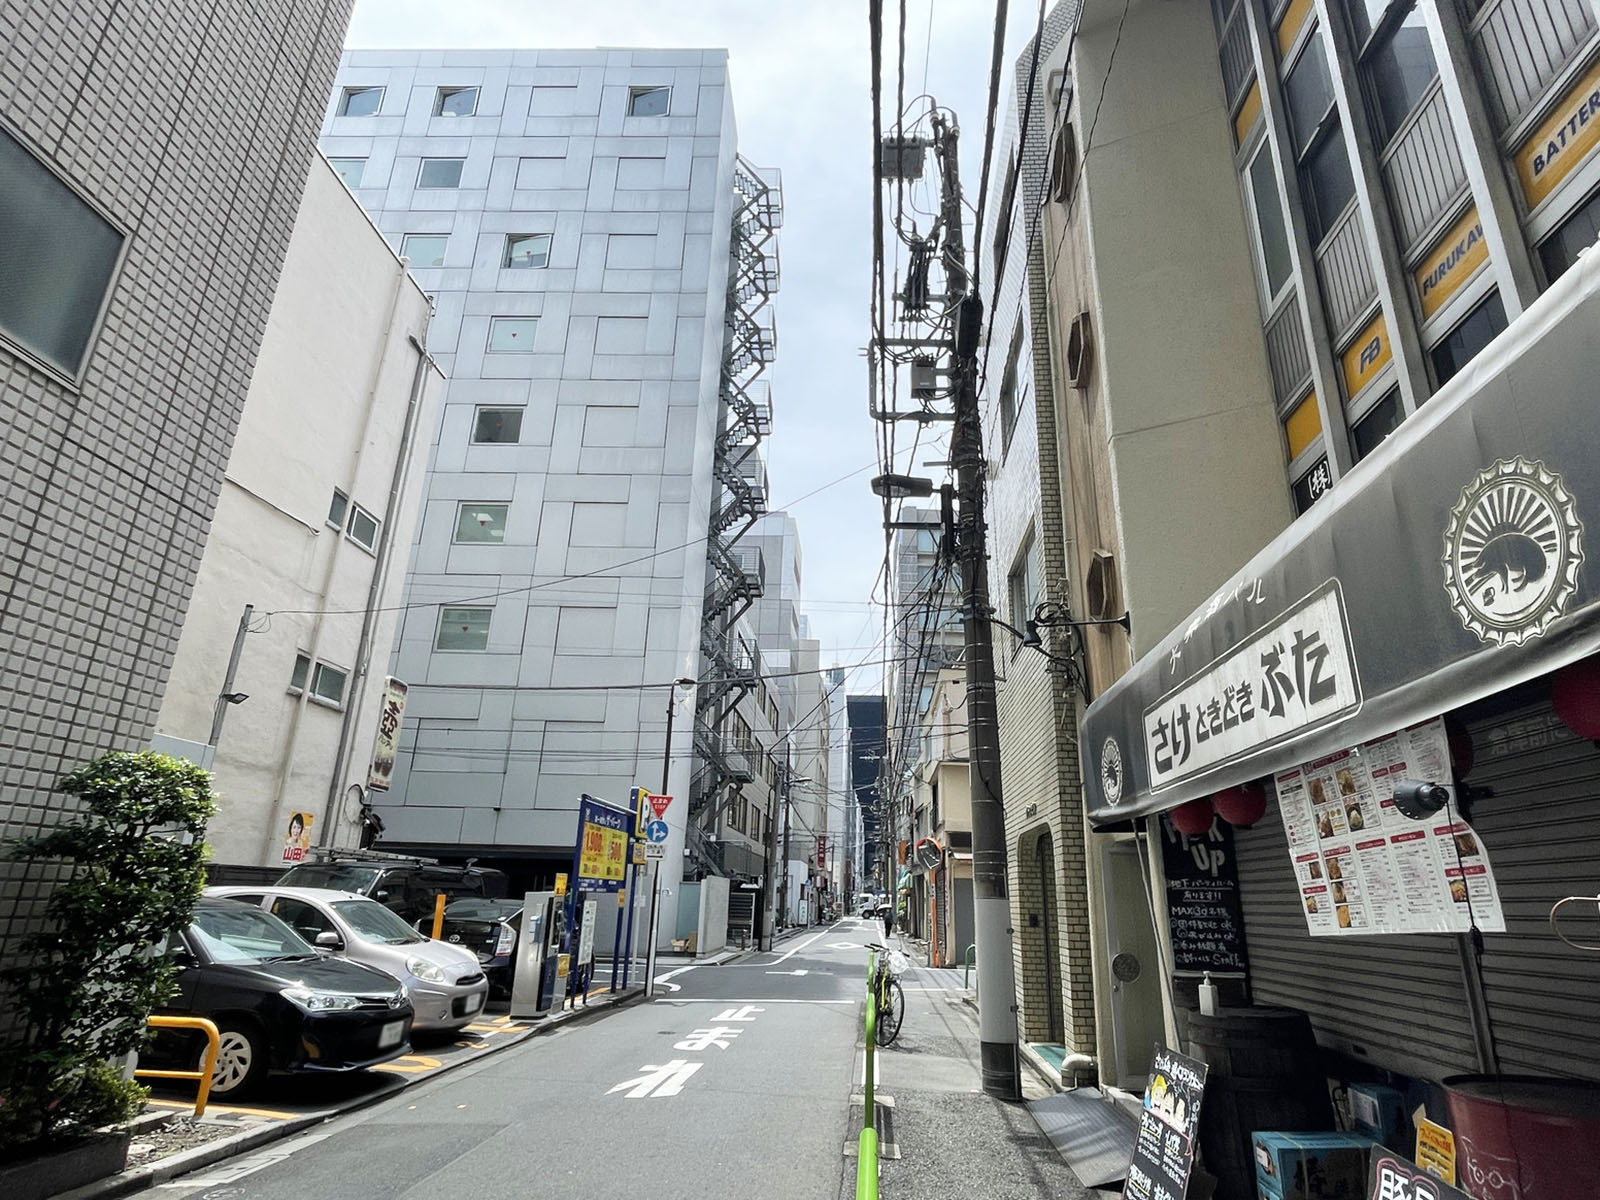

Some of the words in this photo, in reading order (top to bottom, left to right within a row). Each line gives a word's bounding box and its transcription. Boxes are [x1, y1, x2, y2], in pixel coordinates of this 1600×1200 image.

[1360, 336, 1381, 374] FB
[1190, 843, 1226, 877] UP
[603, 1005, 766, 1098] 止まれ
